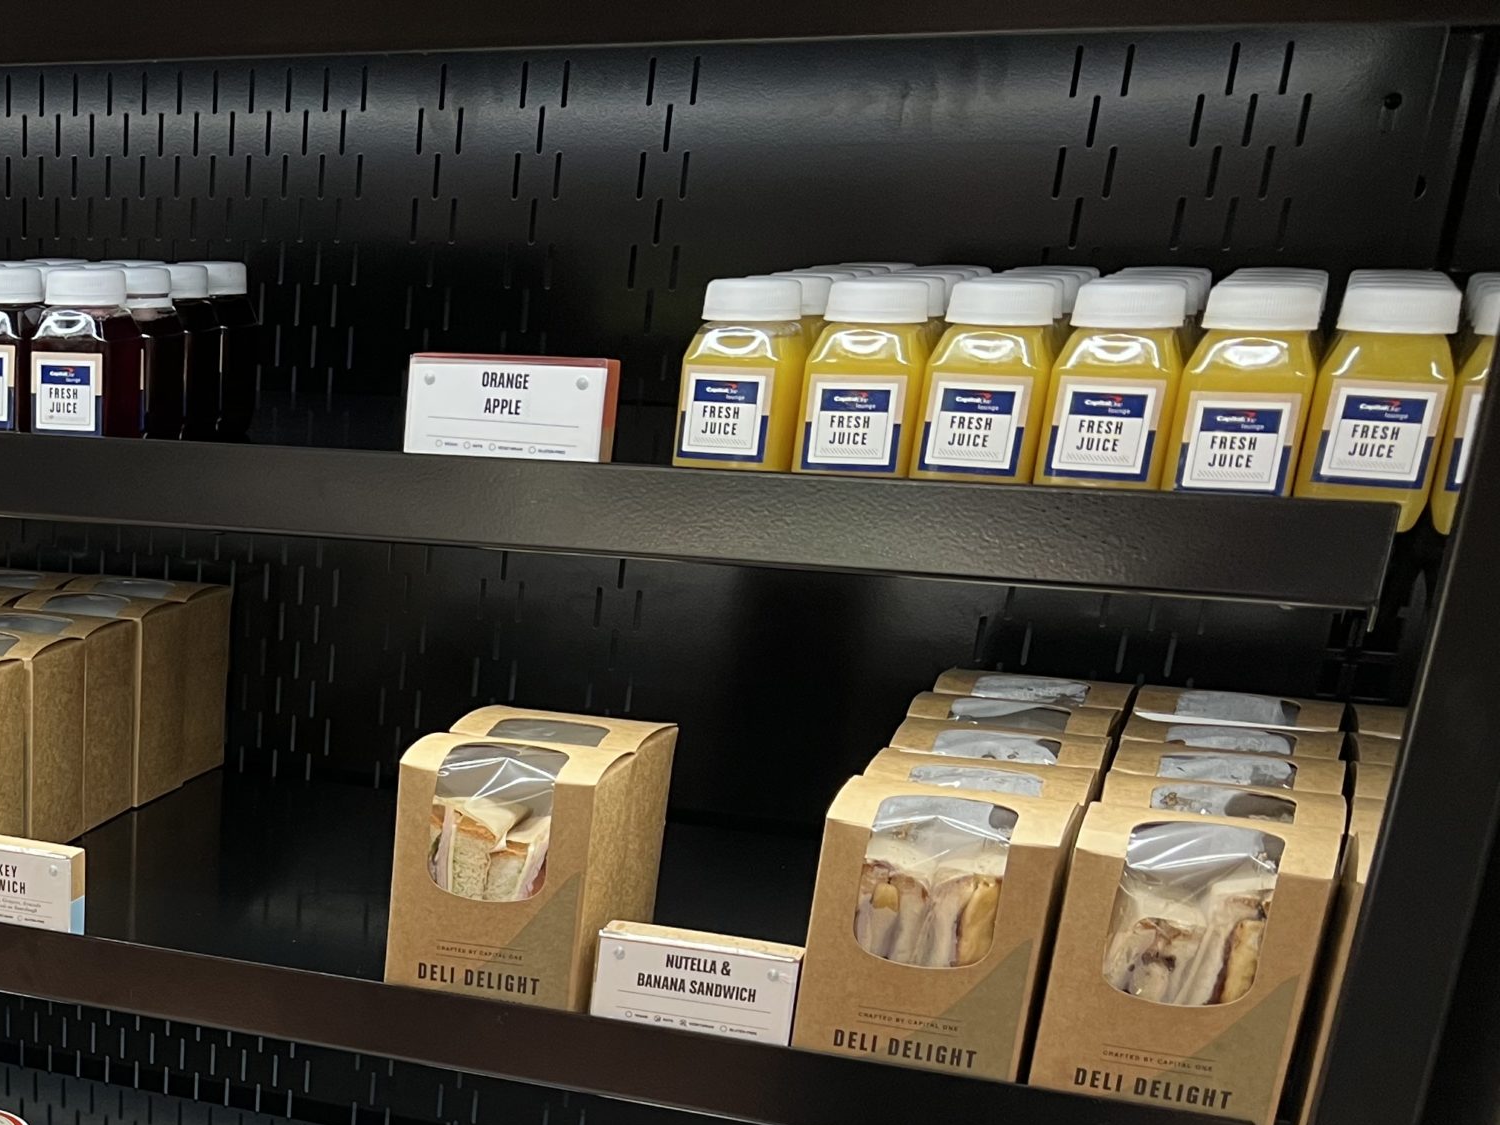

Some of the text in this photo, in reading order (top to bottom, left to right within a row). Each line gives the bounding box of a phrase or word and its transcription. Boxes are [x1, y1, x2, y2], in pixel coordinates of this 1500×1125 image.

[482, 371, 530, 390] ORANGE
[49, 387, 78, 400] FRESH
[50, 401, 77, 414] JUICE
[484, 397, 522, 416] APPLE
[702, 405, 740, 420] FRESH
[701, 422, 737, 436] JUICE
[830, 415, 870, 429] FRESH
[950, 416, 992, 431] FRESH
[1078, 419, 1124, 435] FRESH
[829, 432, 868, 446] JUICE
[1351, 424, 1400, 440] FRESH
[948, 433, 988, 448] JUICE
[1076, 437, 1119, 452] JUICE
[1210, 436, 1257, 451] FRESH
[1348, 444, 1394, 458] JUICE
[1208, 454, 1254, 468] JUICE
[666, 954, 731, 976] NUTELLA &
[418, 962, 540, 996] DELI DELIGHT
[637, 972, 756, 1003] BANANA SANDWICH
[833, 1028, 976, 1068] DELI DELIGHT
[1074, 1067, 1232, 1110] DELI DELIGHT
